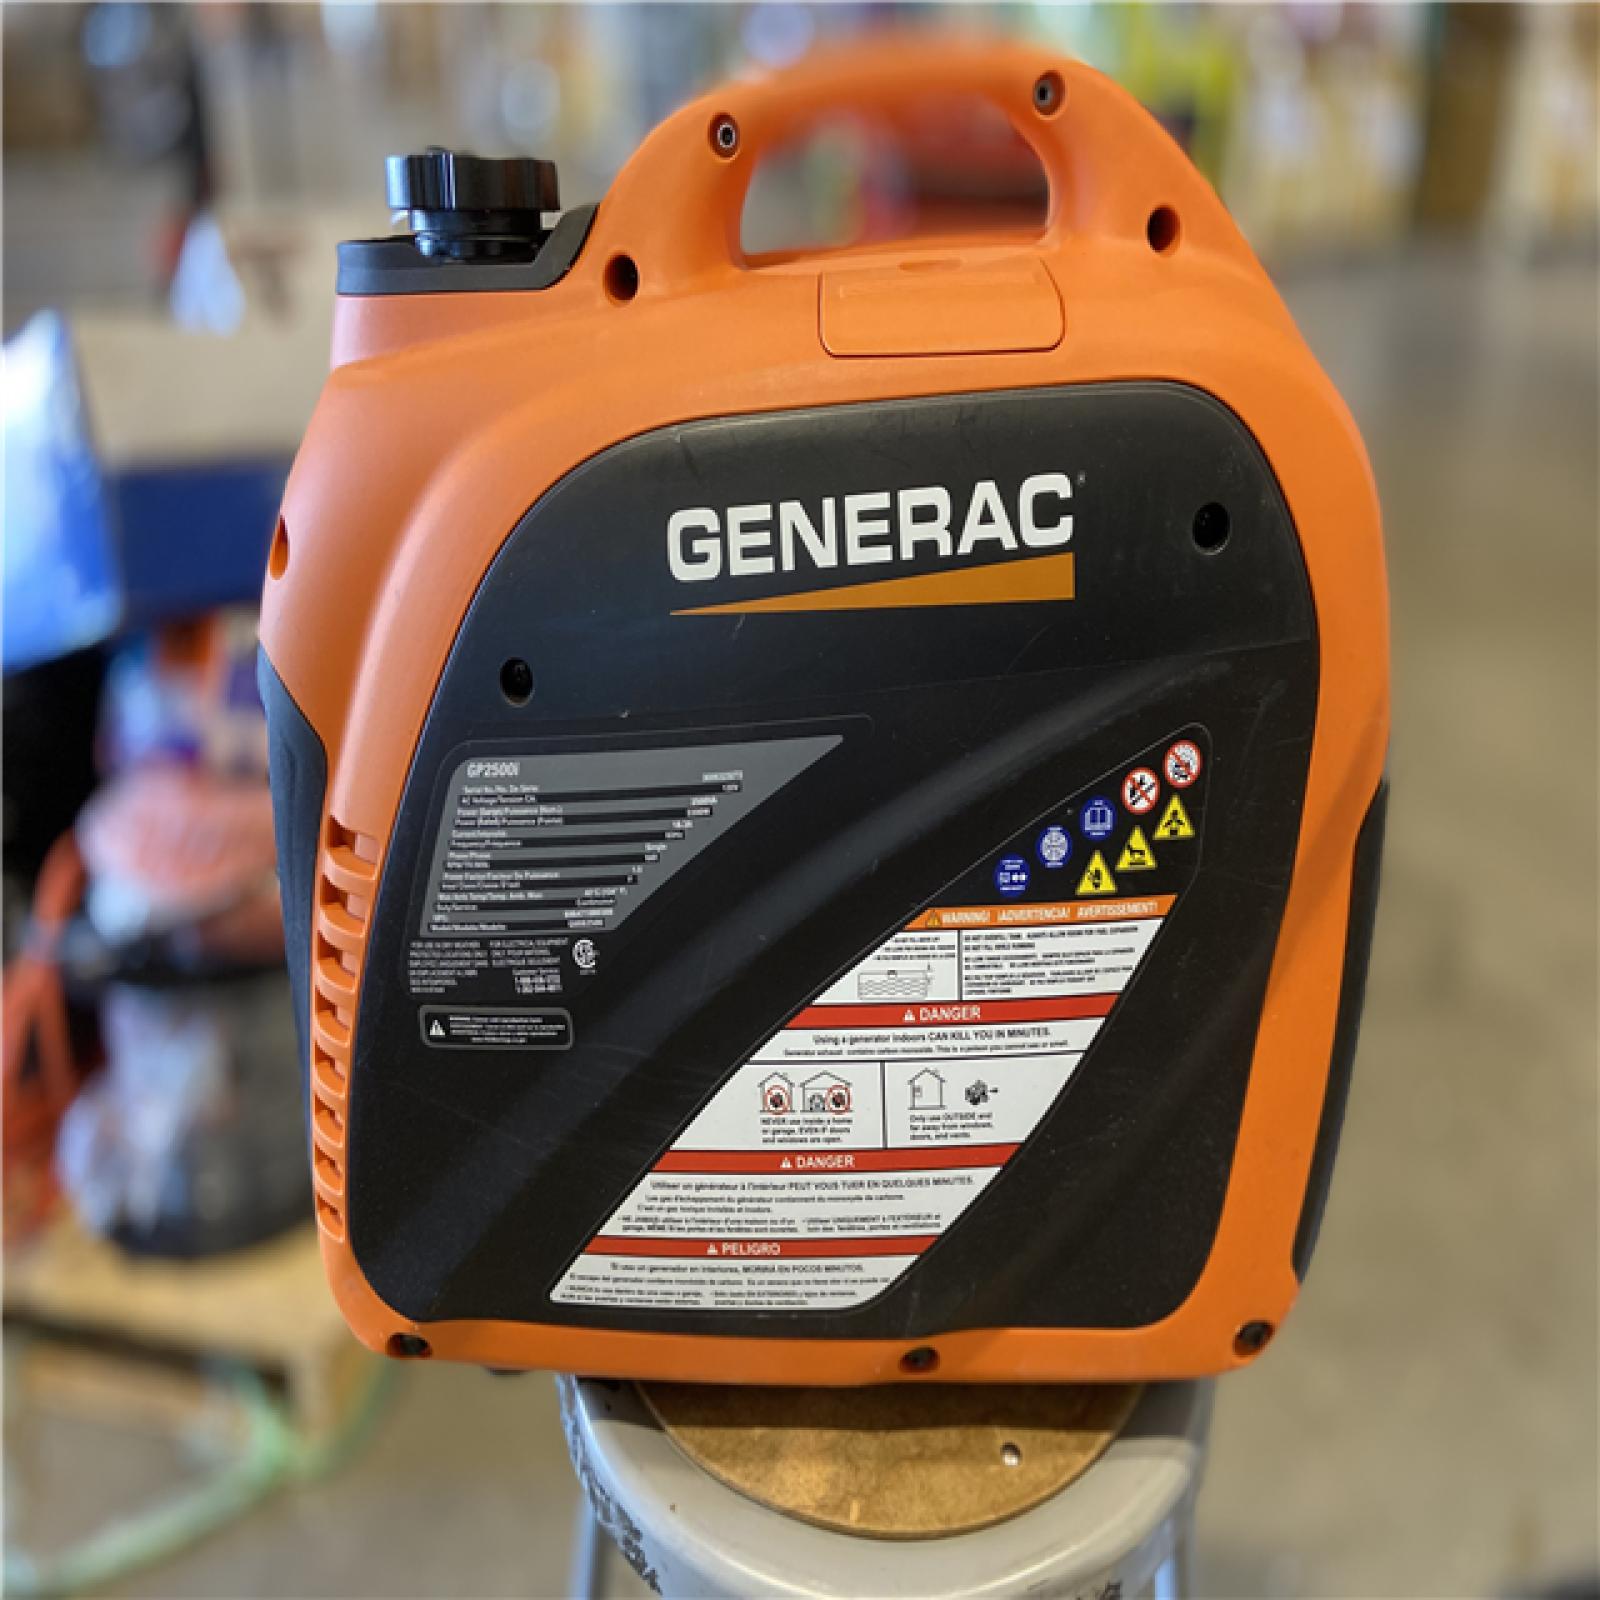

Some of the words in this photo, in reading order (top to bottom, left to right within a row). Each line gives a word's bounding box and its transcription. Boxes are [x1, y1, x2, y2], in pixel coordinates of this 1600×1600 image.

[667, 472, 1074, 582] GENERAC
[467, 762, 520, 778] GP2500i
[942, 910, 990, 923] WARNING!
[1077, 902, 1159, 917] AVERTISSEMENT!
[919, 1005, 981, 1021] DANGER
[812, 1034, 840, 1046] Using
[842, 1034, 848, 1045] a
[849, 1032, 891, 1045] generator
[892, 1031, 926, 1043] indoors
[928, 1030, 950, 1042] CAN
[951, 1030, 972, 1041] KILL
[973, 1029, 993, 1040] YOU
[995, 1029, 1006, 1039] IN
[796, 1154, 855, 1169] DANGER
[722, 1243, 781, 1256] PELIGRO
